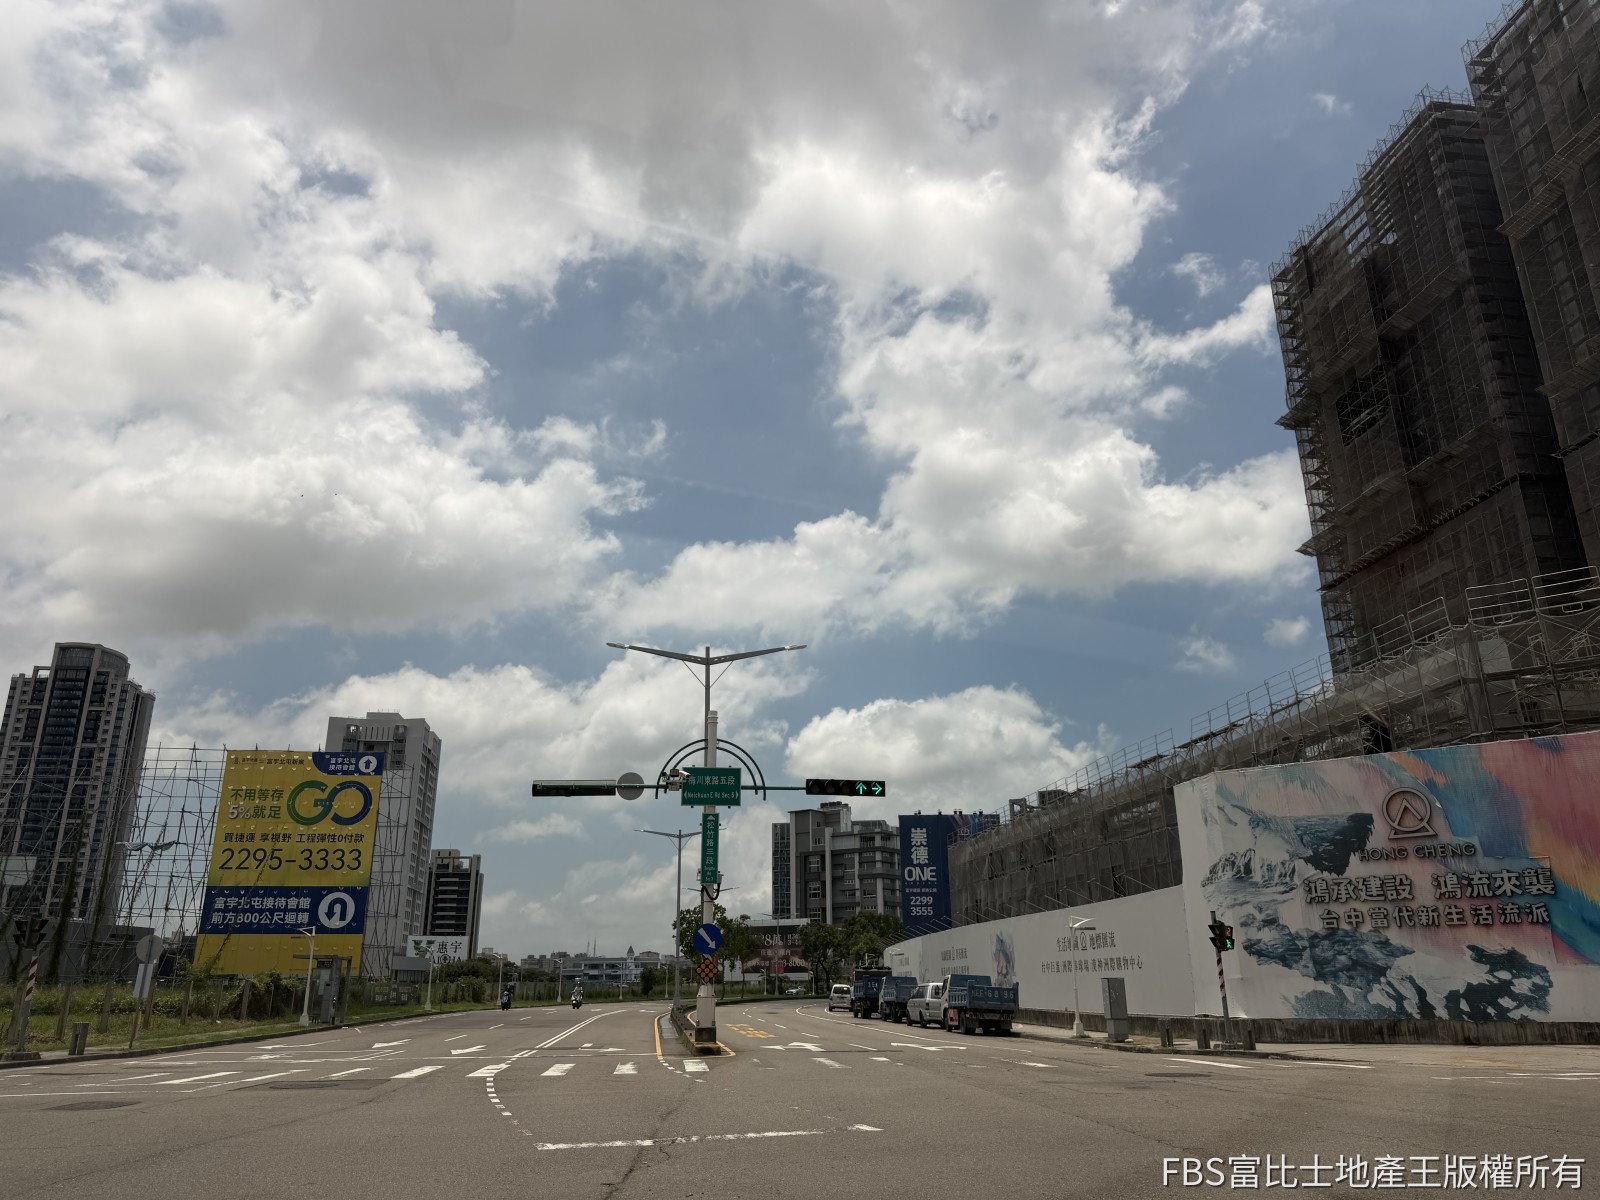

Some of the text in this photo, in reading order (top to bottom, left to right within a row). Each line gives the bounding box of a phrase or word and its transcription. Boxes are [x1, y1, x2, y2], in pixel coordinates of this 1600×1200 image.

[688, 775, 735, 786] 梅川東路五段
[230, 788, 284, 802] 不用等存
[228, 805, 282, 819] 5%就足
[223, 833, 365, 844] 買捷運 享視野 工程彈性0付款
[706, 821, 715, 865] 松竹路三段
[910, 828, 929, 865] 崇德
[1358, 843, 1476, 862] HONG CHENG
[218, 848, 362, 871] 2295-3333
[904, 867, 937, 881] ONE
[1303, 868, 1556, 904] 鴻承建設 鴻流來襲
[214, 897, 312, 909] 富宇北屯接待會館
[910, 896, 933, 905] 2299
[210, 912, 310, 924] 前方800公尺迴轉
[910, 907, 934, 916] 3555
[1319, 902, 1551, 929] 台中當代新生活流派
[436, 940, 463, 953] 惠宇
